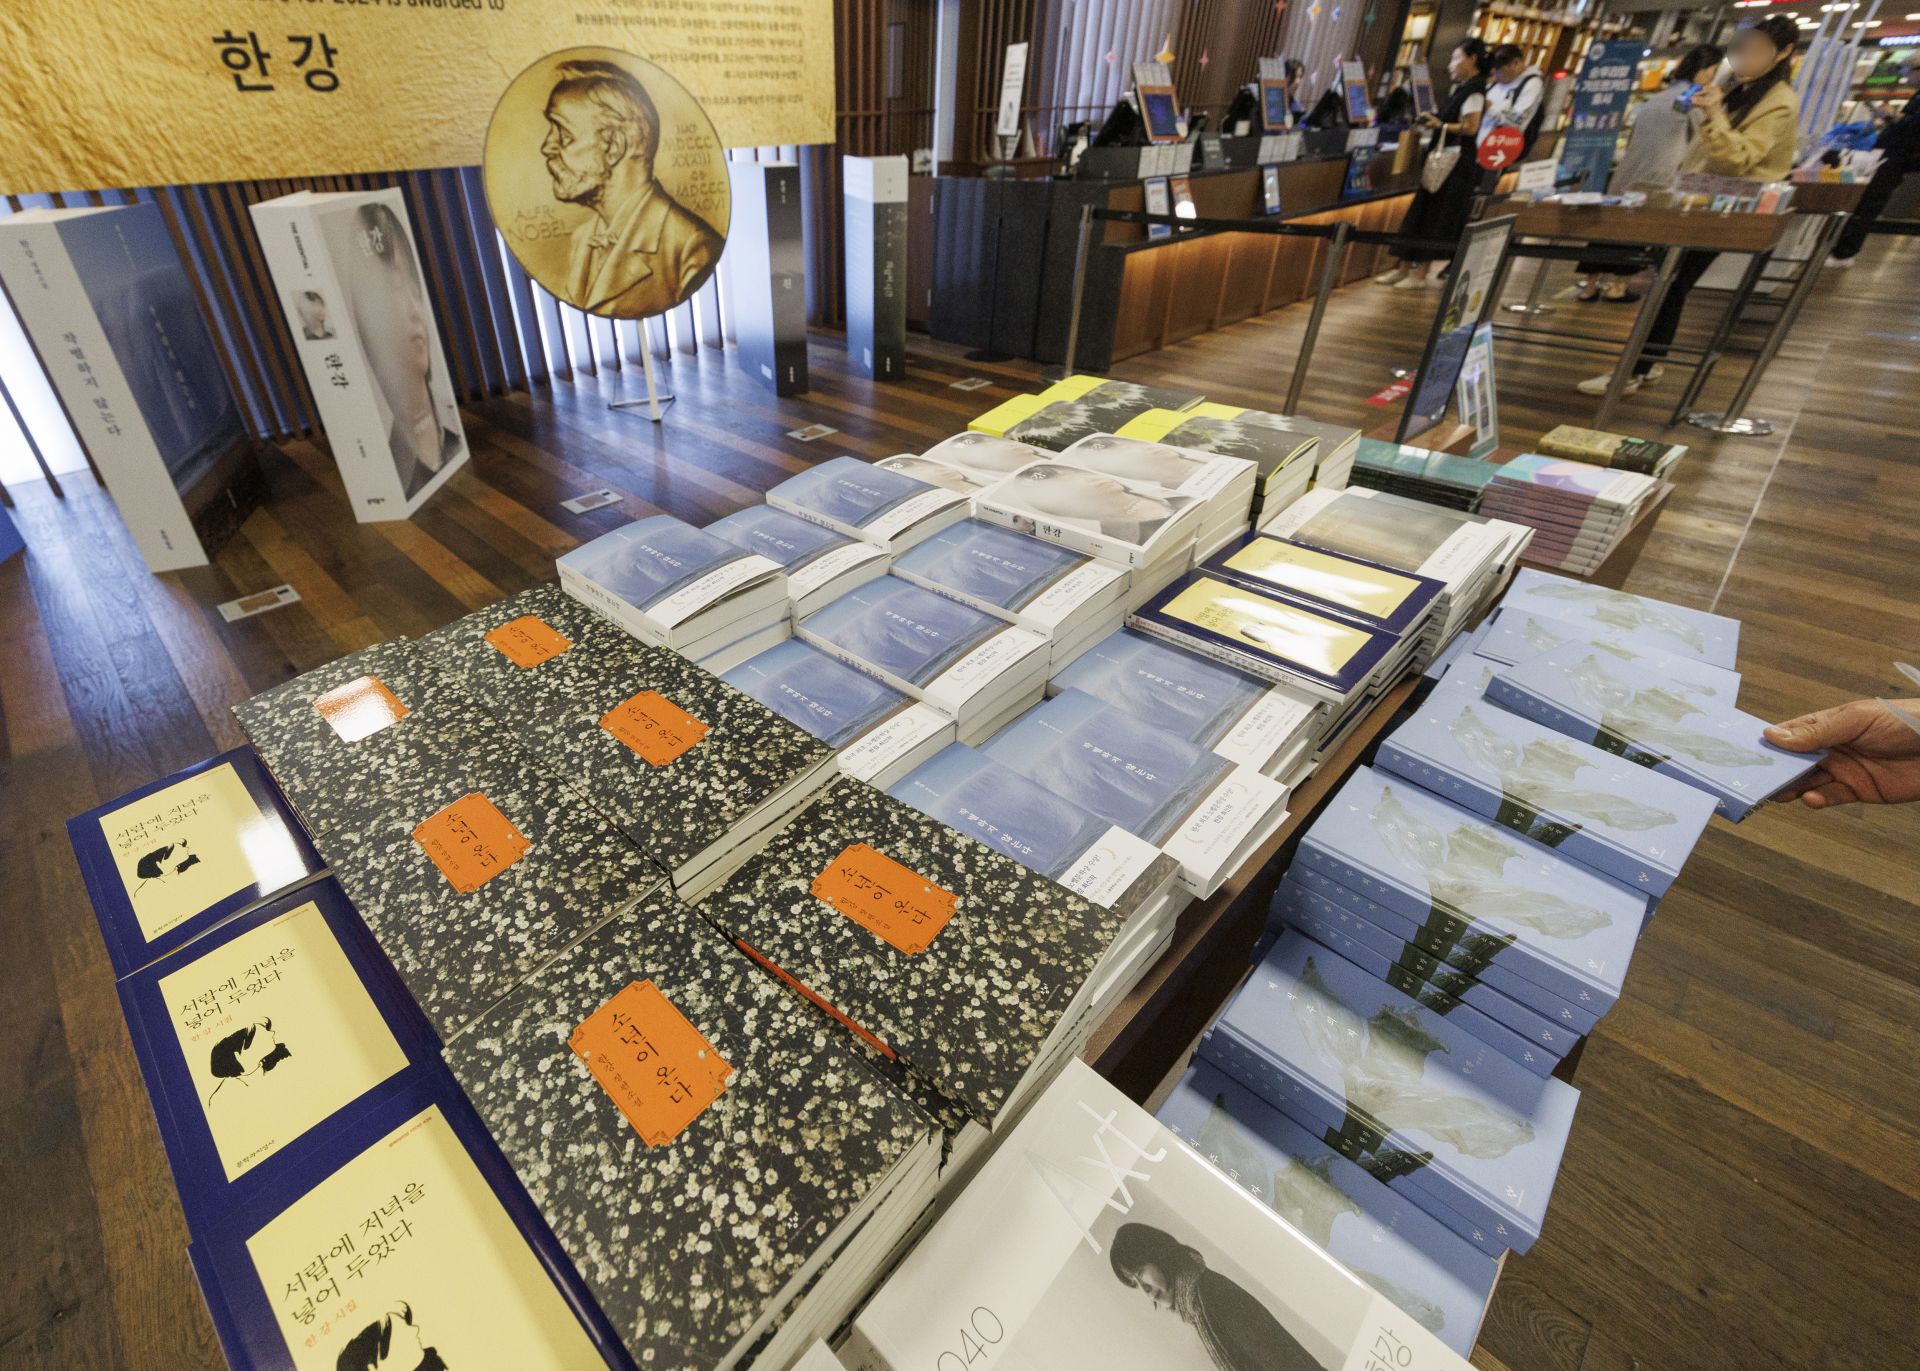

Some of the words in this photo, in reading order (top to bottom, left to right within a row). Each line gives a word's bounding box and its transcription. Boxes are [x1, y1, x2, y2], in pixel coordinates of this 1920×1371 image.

[627, 707, 660, 730] 소년이
[659, 730, 684, 747] 온다
[115, 814, 163, 841] 서랍에
[118, 833, 149, 850] 넣어
[153, 808, 199, 833] 두었다
[446, 813, 478, 844] 소년이
[473, 844, 498, 867] 온다
[841, 865, 893, 900] 소년이
[894, 900, 932, 925] 온다
[180, 977, 237, 1016] 서랍에
[242, 947, 296, 981] 저녁을
[184, 1003, 222, 1030] 넣어
[227, 969, 283, 1004] 두었다
[612, 1012, 660, 1063] 소년이
[656, 1066, 693, 1103] 온다
[284, 1233, 355, 1302] 서랍에
[359, 1179, 426, 1238] 저녁을
[291, 1278, 341, 1325] 넣어
[345, 1218, 416, 1281] 두었다
